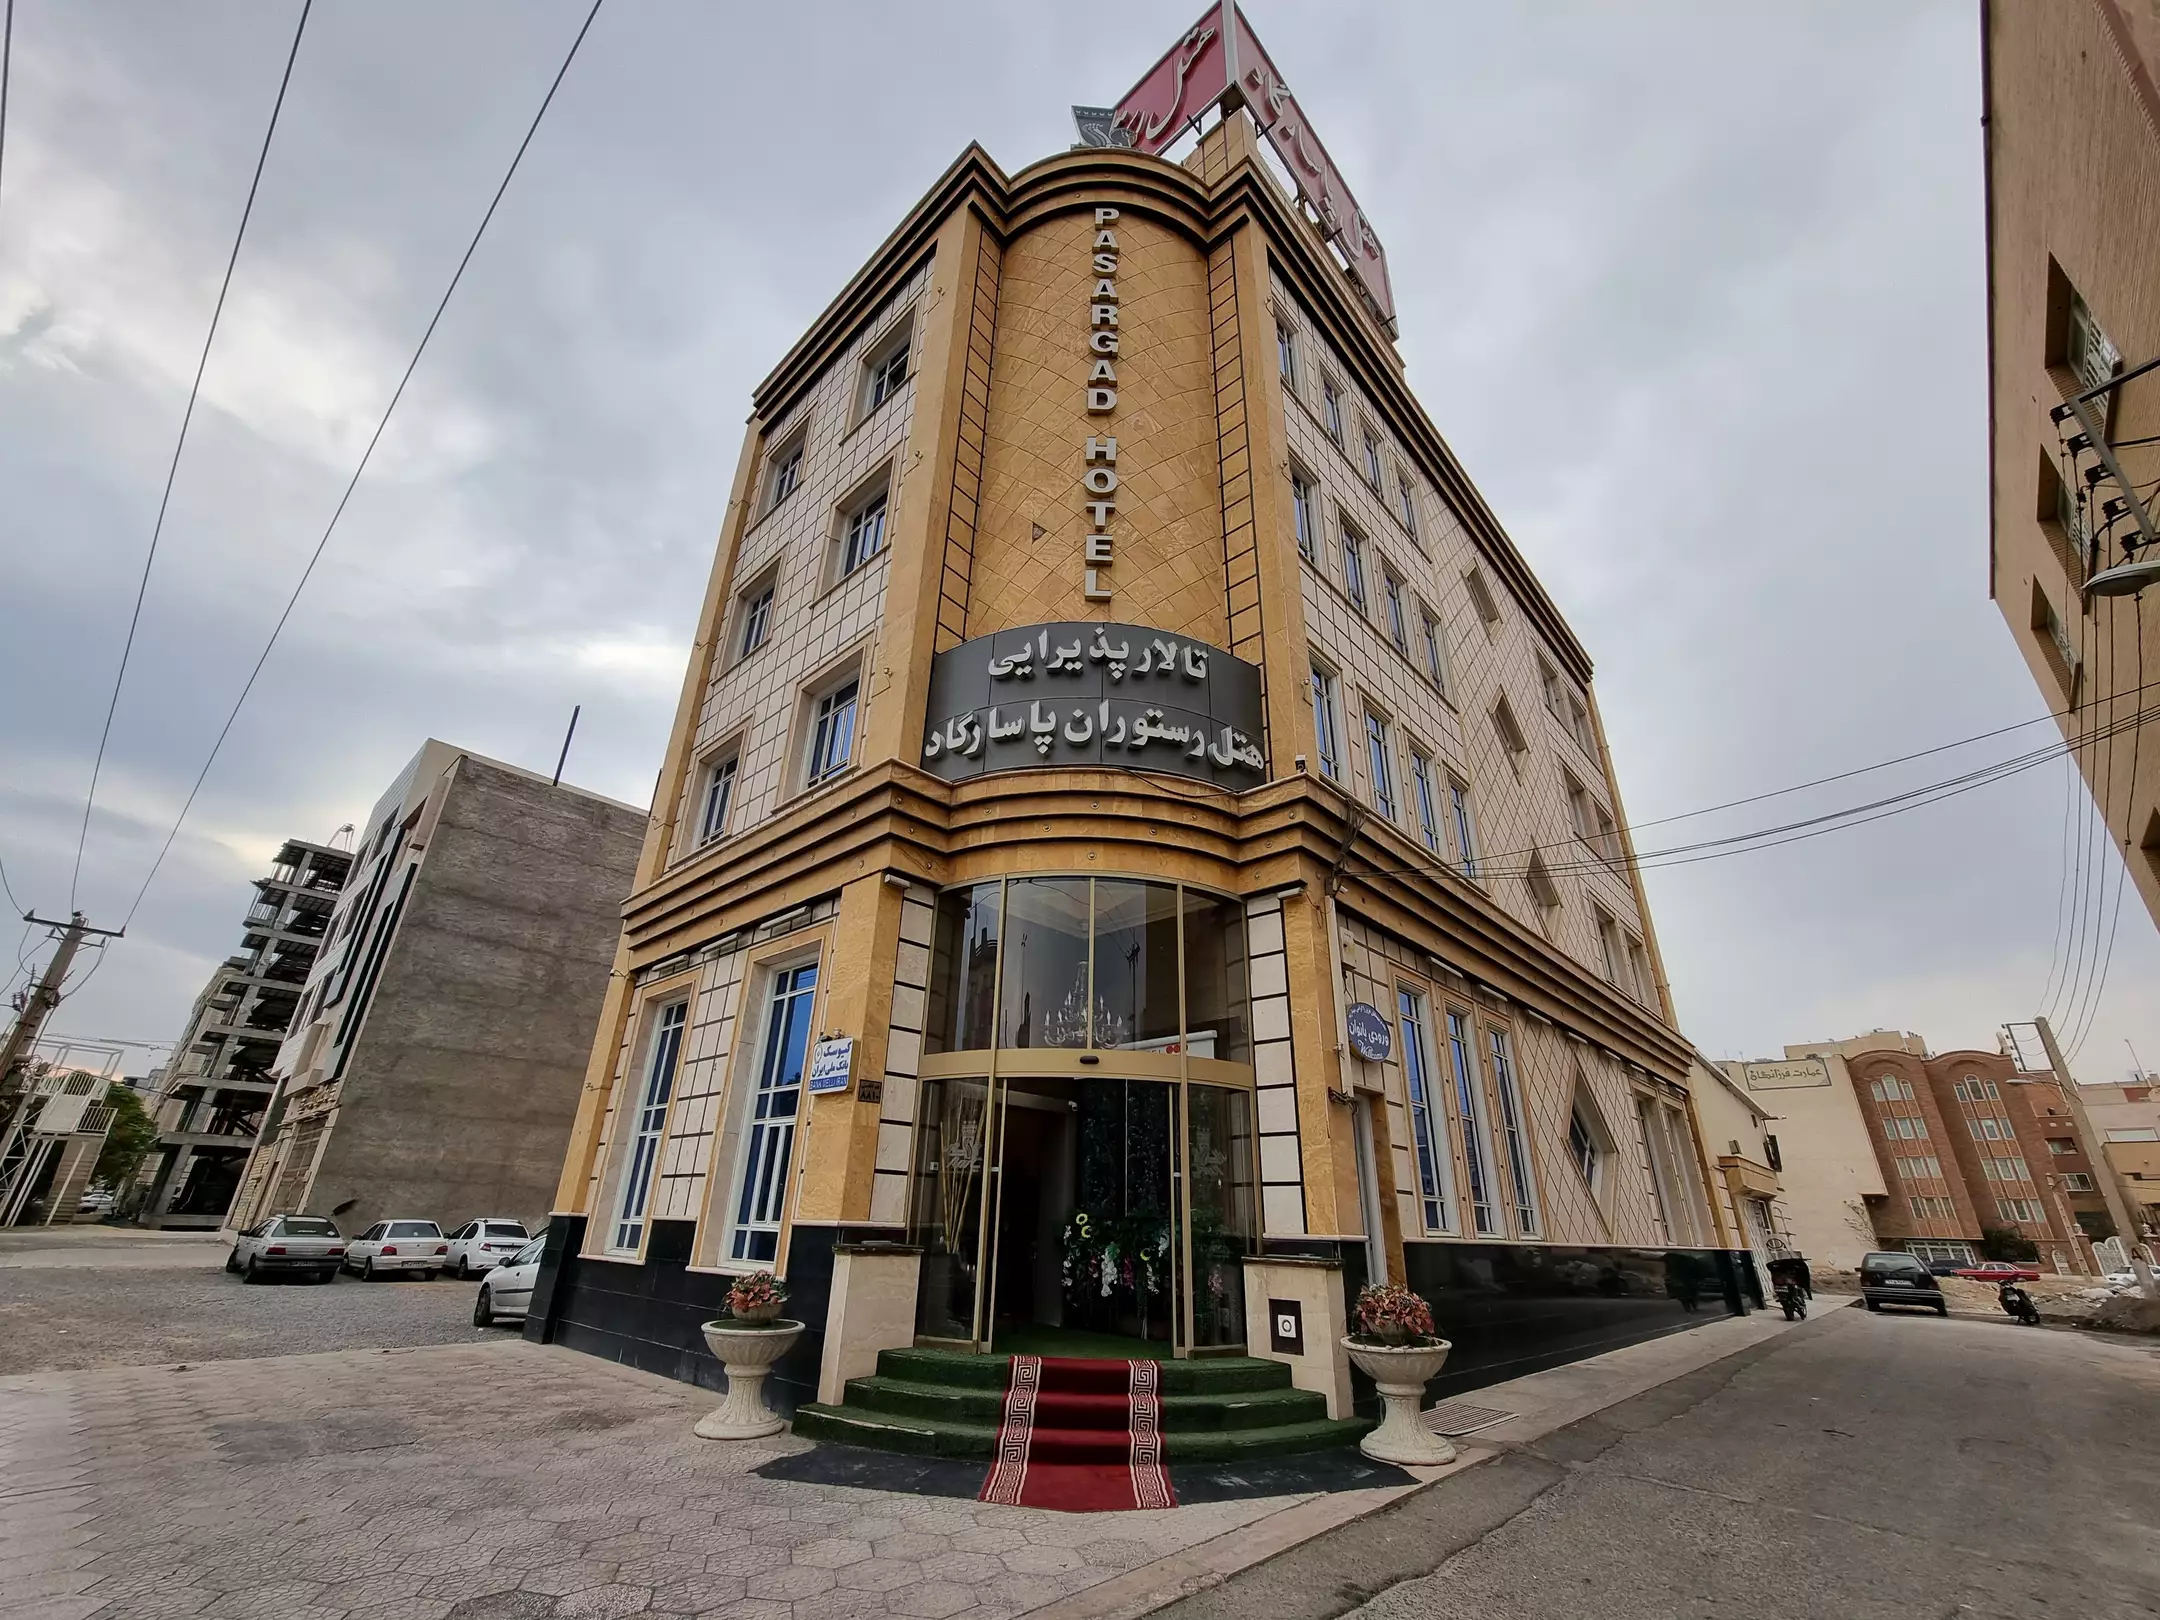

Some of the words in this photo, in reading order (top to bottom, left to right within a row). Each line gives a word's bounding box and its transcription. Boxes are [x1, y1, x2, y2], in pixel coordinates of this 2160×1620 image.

[1145, 26, 1216, 140] هتل
[1087, 207, 1120, 415] PASARGAD
[1084, 436, 1118, 602] HOTEL
[987, 626, 1131, 681] پذیرایی
[1131, 637, 1209, 680] تالار
[925, 699, 1058, 758] پاسارگاد
[1063, 698, 1206, 757] رستوران
[1207, 725, 1265, 771] هتل
[1349, 1019, 1367, 1042] بانوان
[1368, 1031, 1389, 1047] ورودی
[809, 1079, 822, 1090] BANK
[836, 1076, 847, 1086] IRAN
[811, 1064, 826, 1078] ایران
[825, 1061, 836, 1075] ملی
[836, 1060, 848, 1072] بانک
[1792, 1066, 1823, 1078] عمارت
